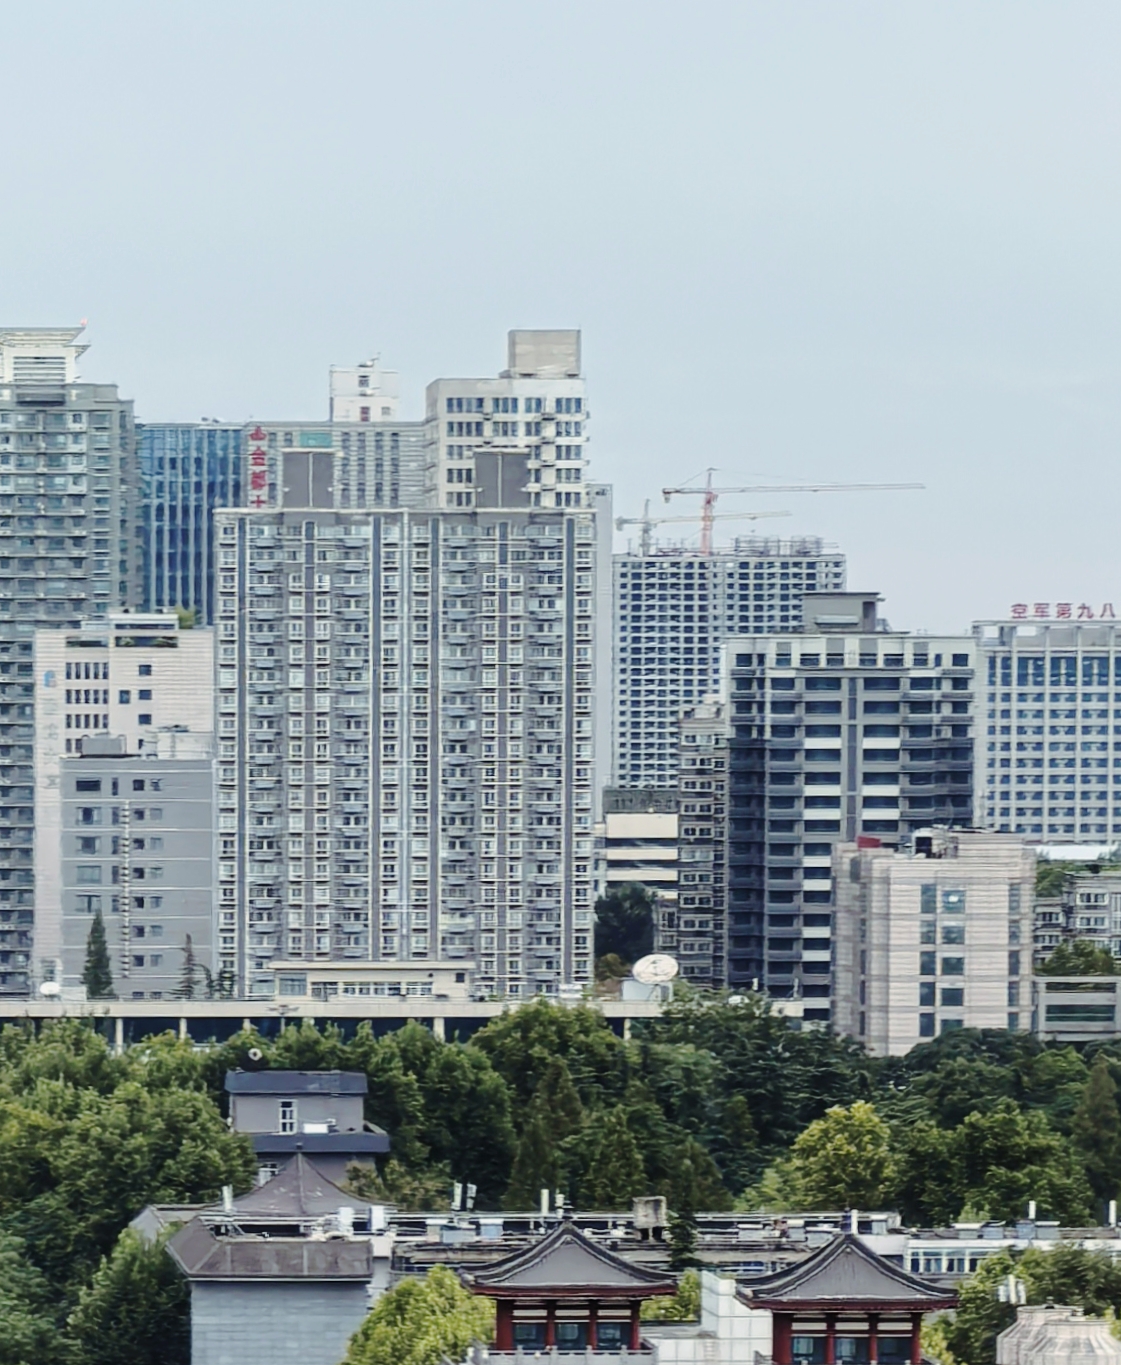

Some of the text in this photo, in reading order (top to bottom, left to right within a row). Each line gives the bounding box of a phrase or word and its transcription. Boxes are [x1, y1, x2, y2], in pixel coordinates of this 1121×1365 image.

[1010, 602, 1116, 619] 空军第九八
